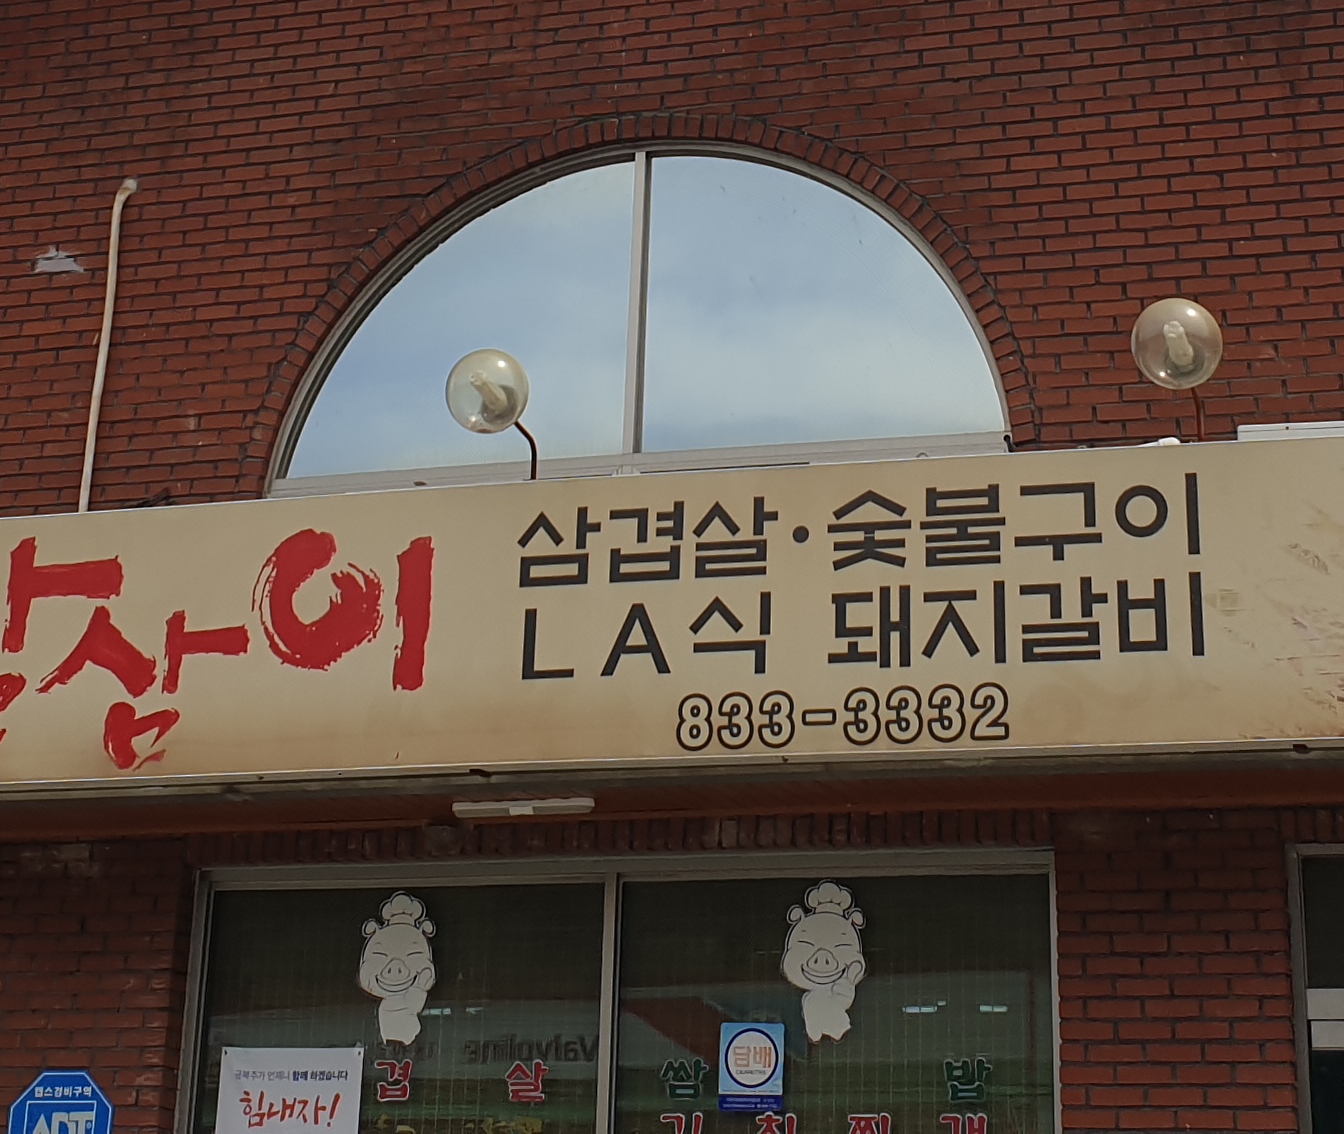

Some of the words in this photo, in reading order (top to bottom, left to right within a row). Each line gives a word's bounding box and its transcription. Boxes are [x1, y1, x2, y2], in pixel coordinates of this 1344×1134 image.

[827, 571, 1206, 669] 돼지갈비
[675, 682, 1010, 751] 833-3332
[733, 1046, 773, 1069] 담배
[35, 1086, 92, 1098] 캡스경비구역
[239, 1090, 341, 1129] 힘내자!
